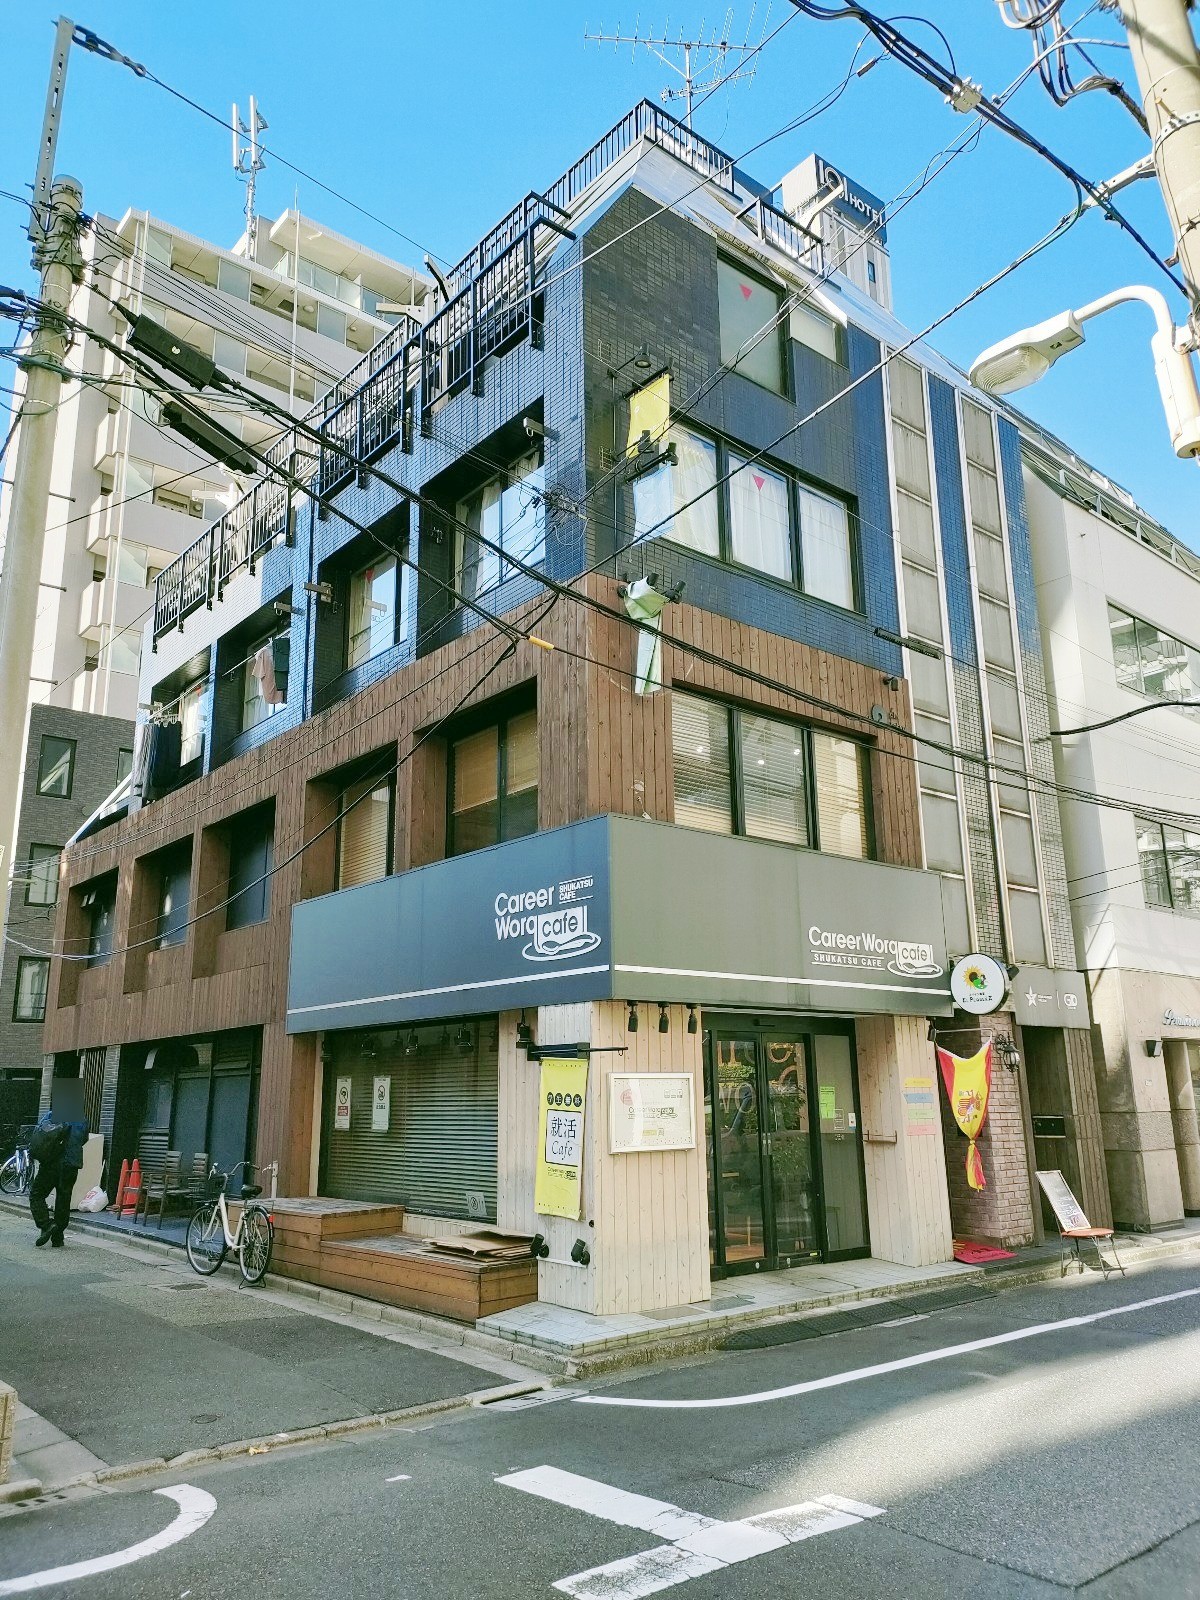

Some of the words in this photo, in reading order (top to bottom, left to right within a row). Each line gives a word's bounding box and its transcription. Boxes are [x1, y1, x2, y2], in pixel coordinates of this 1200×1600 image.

[849, 192, 884, 227] HOTEL
[559, 878, 593, 894] SHUKATSU
[559, 891, 576, 901] CAFE
[494, 886, 554, 916] Career
[542, 912, 578, 937] cafe
[813, 952, 858, 965] SHUKATSU
[861, 958, 882, 967] CAFE
[901, 946, 928, 961] cafe
[550, 1116, 577, 1139] 就活
[552, 1140, 573, 1161] Cafe
